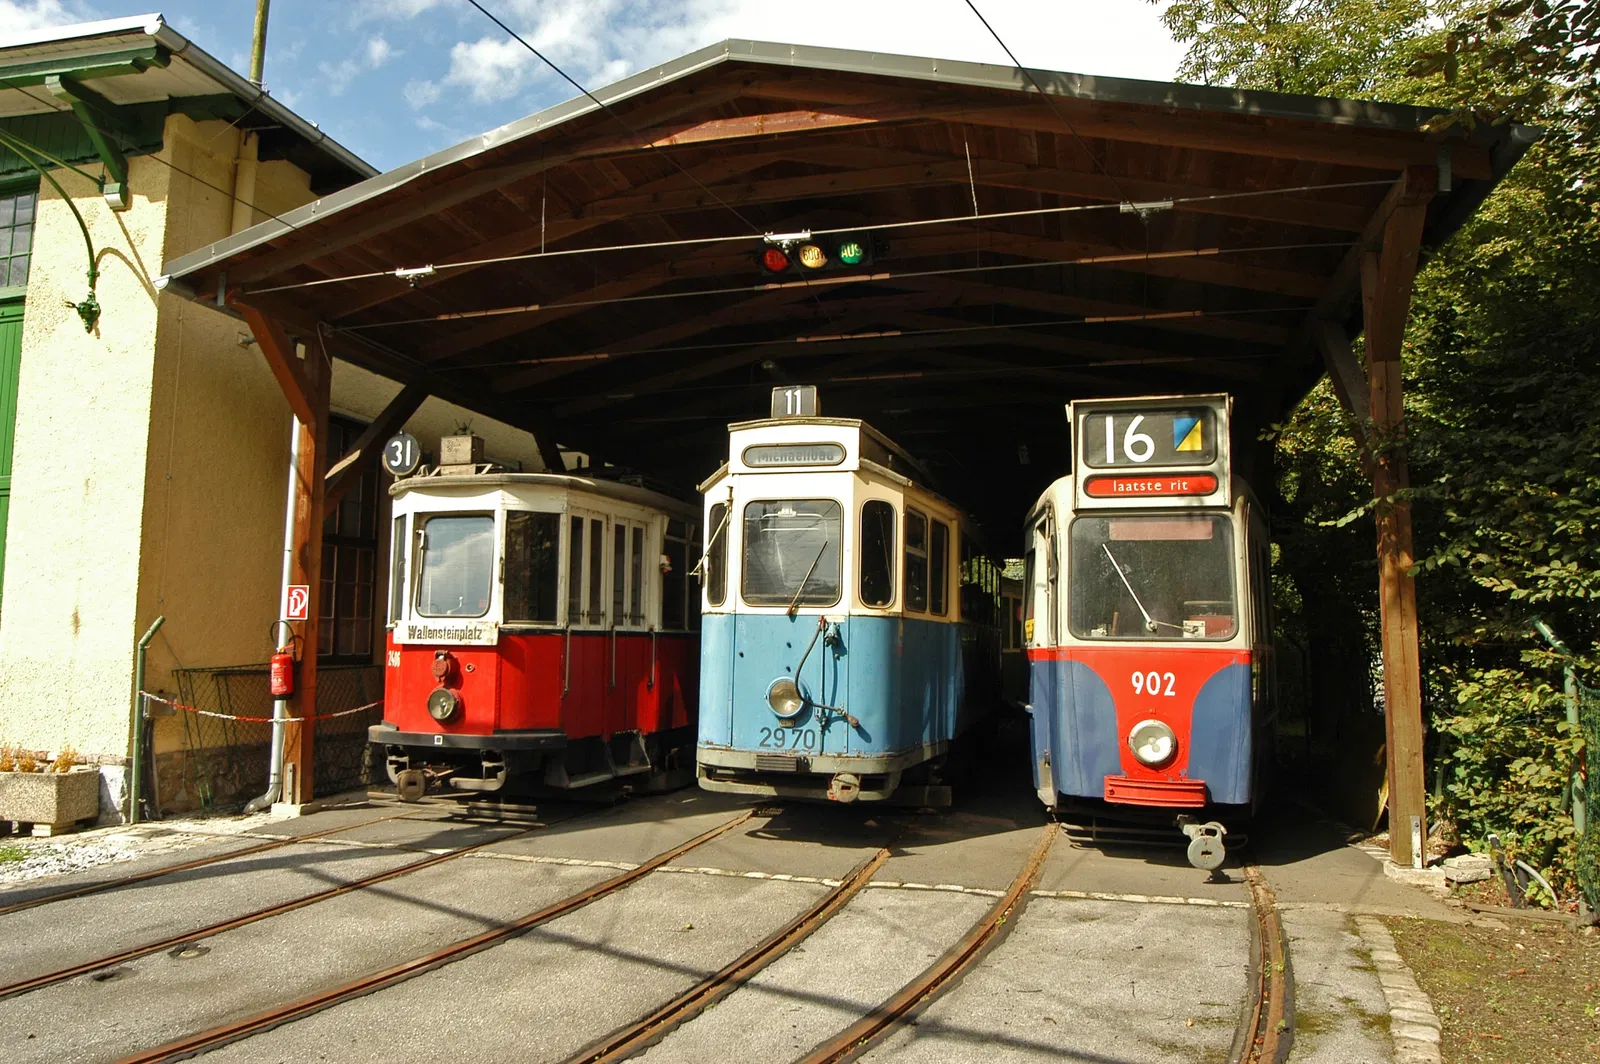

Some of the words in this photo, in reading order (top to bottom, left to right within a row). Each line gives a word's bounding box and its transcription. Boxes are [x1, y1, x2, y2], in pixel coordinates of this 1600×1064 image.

[841, 243, 862, 258] AUS
[785, 389, 801, 415] 11
[1105, 414, 1155, 464] 16
[390, 440, 411, 467] 31
[1113, 480, 1162, 492] laatste
[1171, 480, 1188, 490] rit
[408, 625, 482, 641] Wallensteinplatz
[1131, 671, 1176, 696] 902
[759, 727, 816, 749] 2970
